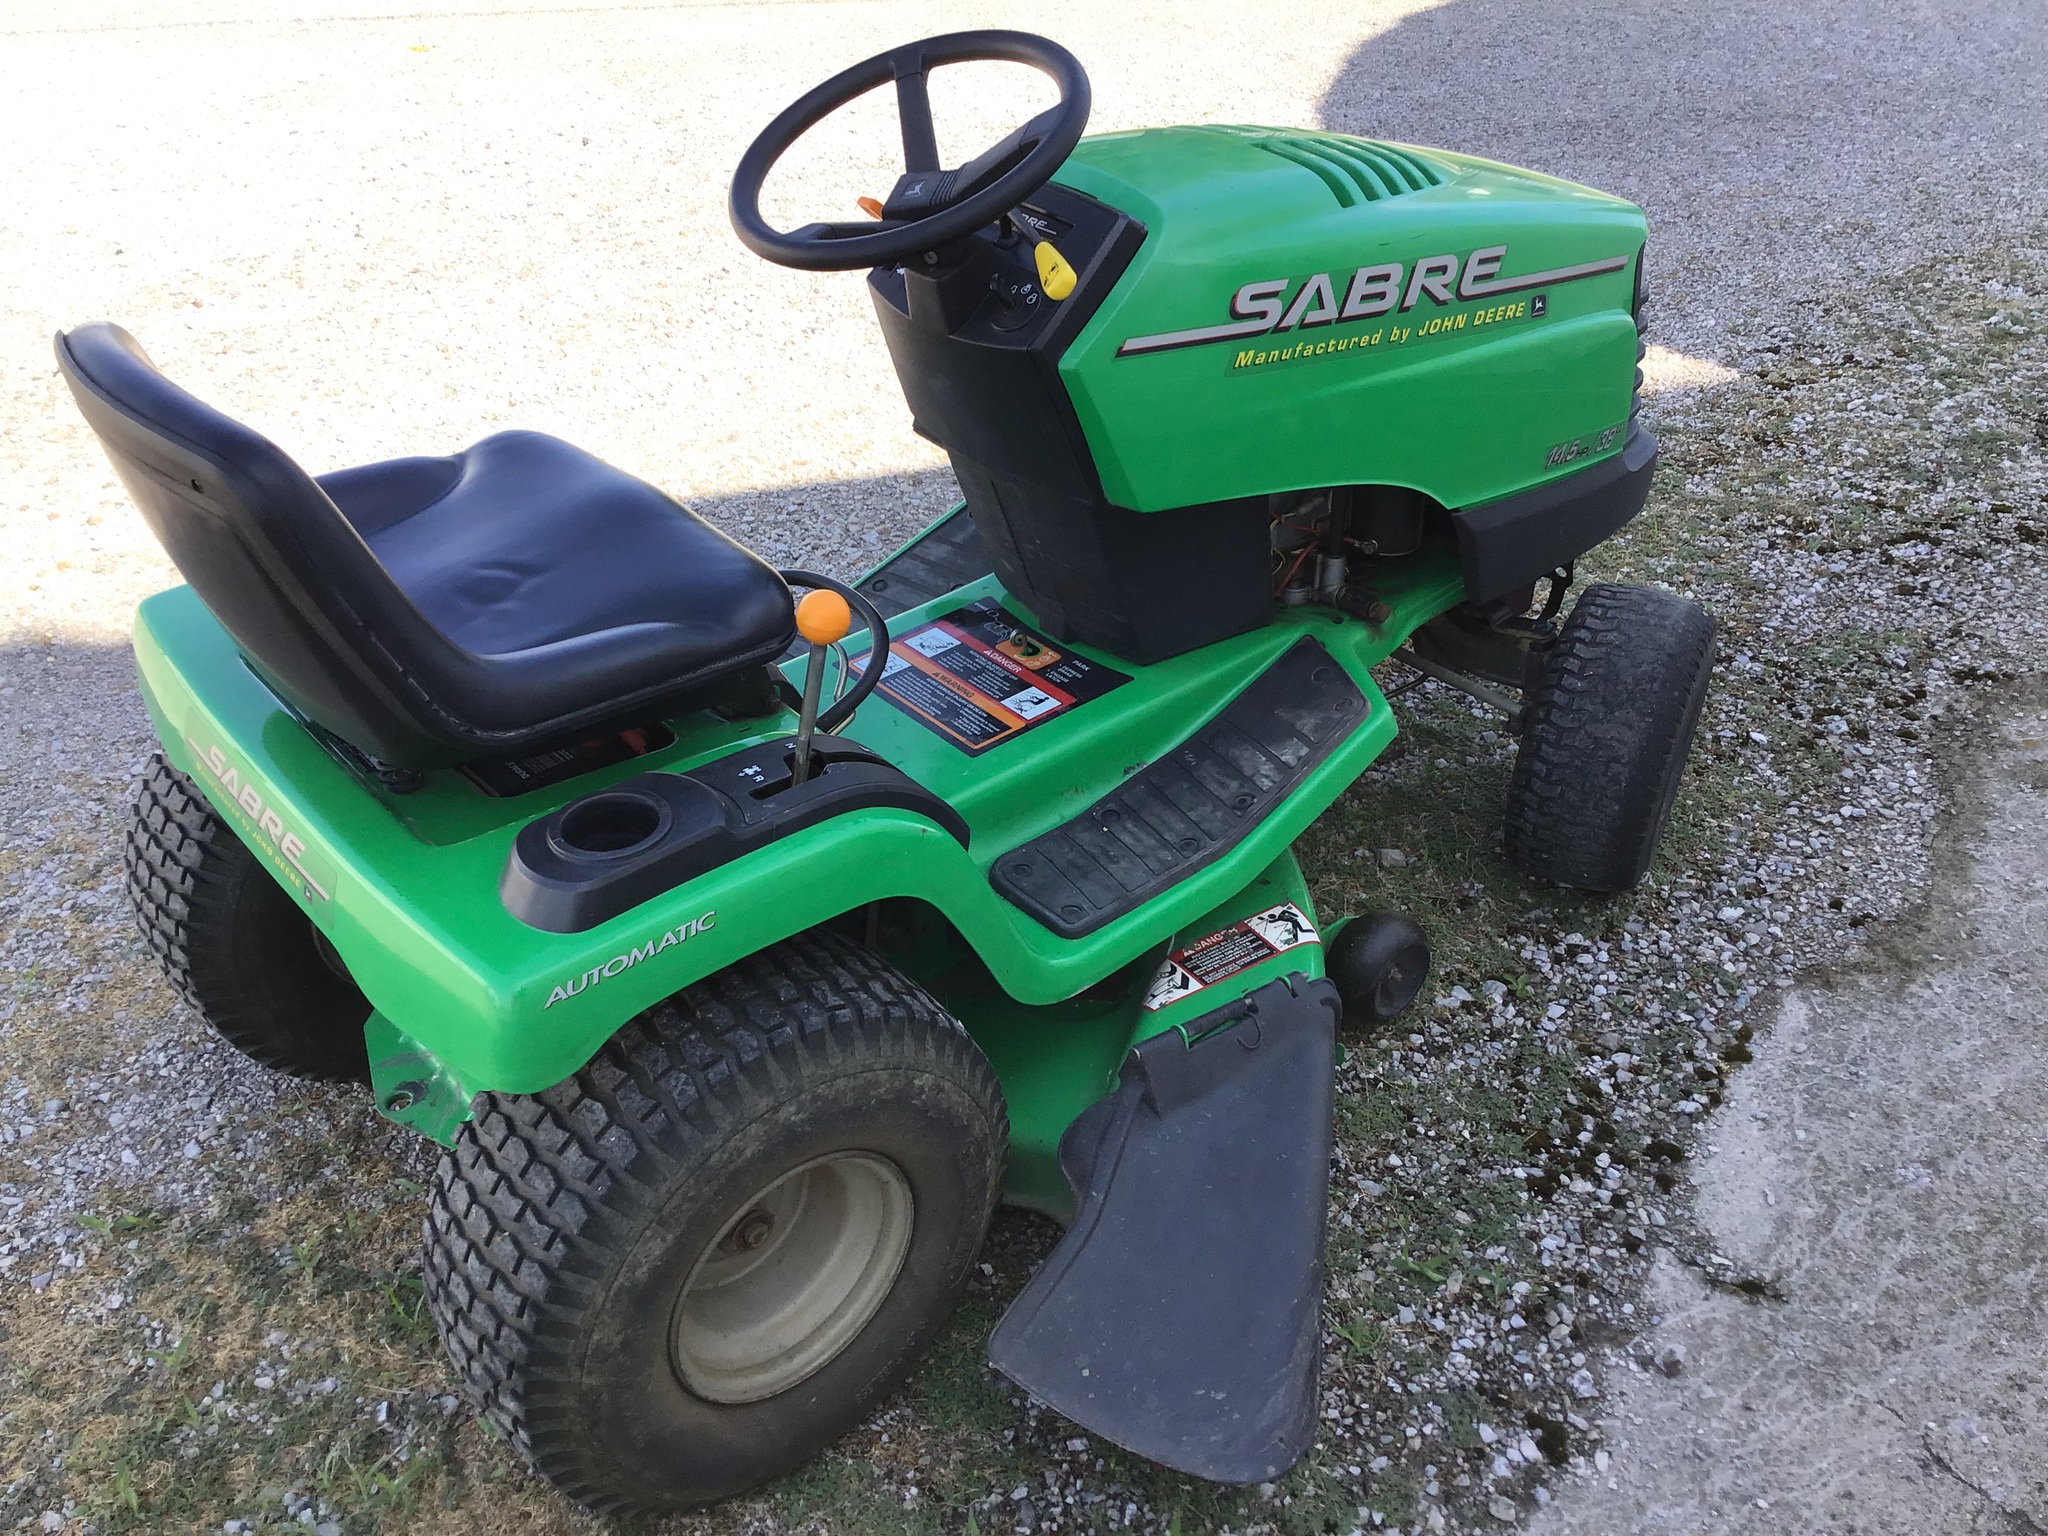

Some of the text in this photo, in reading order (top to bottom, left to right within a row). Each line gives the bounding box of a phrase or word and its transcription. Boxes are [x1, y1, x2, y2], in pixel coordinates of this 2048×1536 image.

[1229, 244, 1508, 336] SABRE
[1232, 301, 1527, 369] Manufactured by JOHN DEERE
[936, 673, 976, 699] WARNING
[988, 652, 1024, 673] DANGER
[1070, 659, 1092, 672] PARK
[208, 744, 306, 860] SABRE
[274, 855, 302, 889] DEERE
[543, 910, 718, 1010] AUTOMATIC
